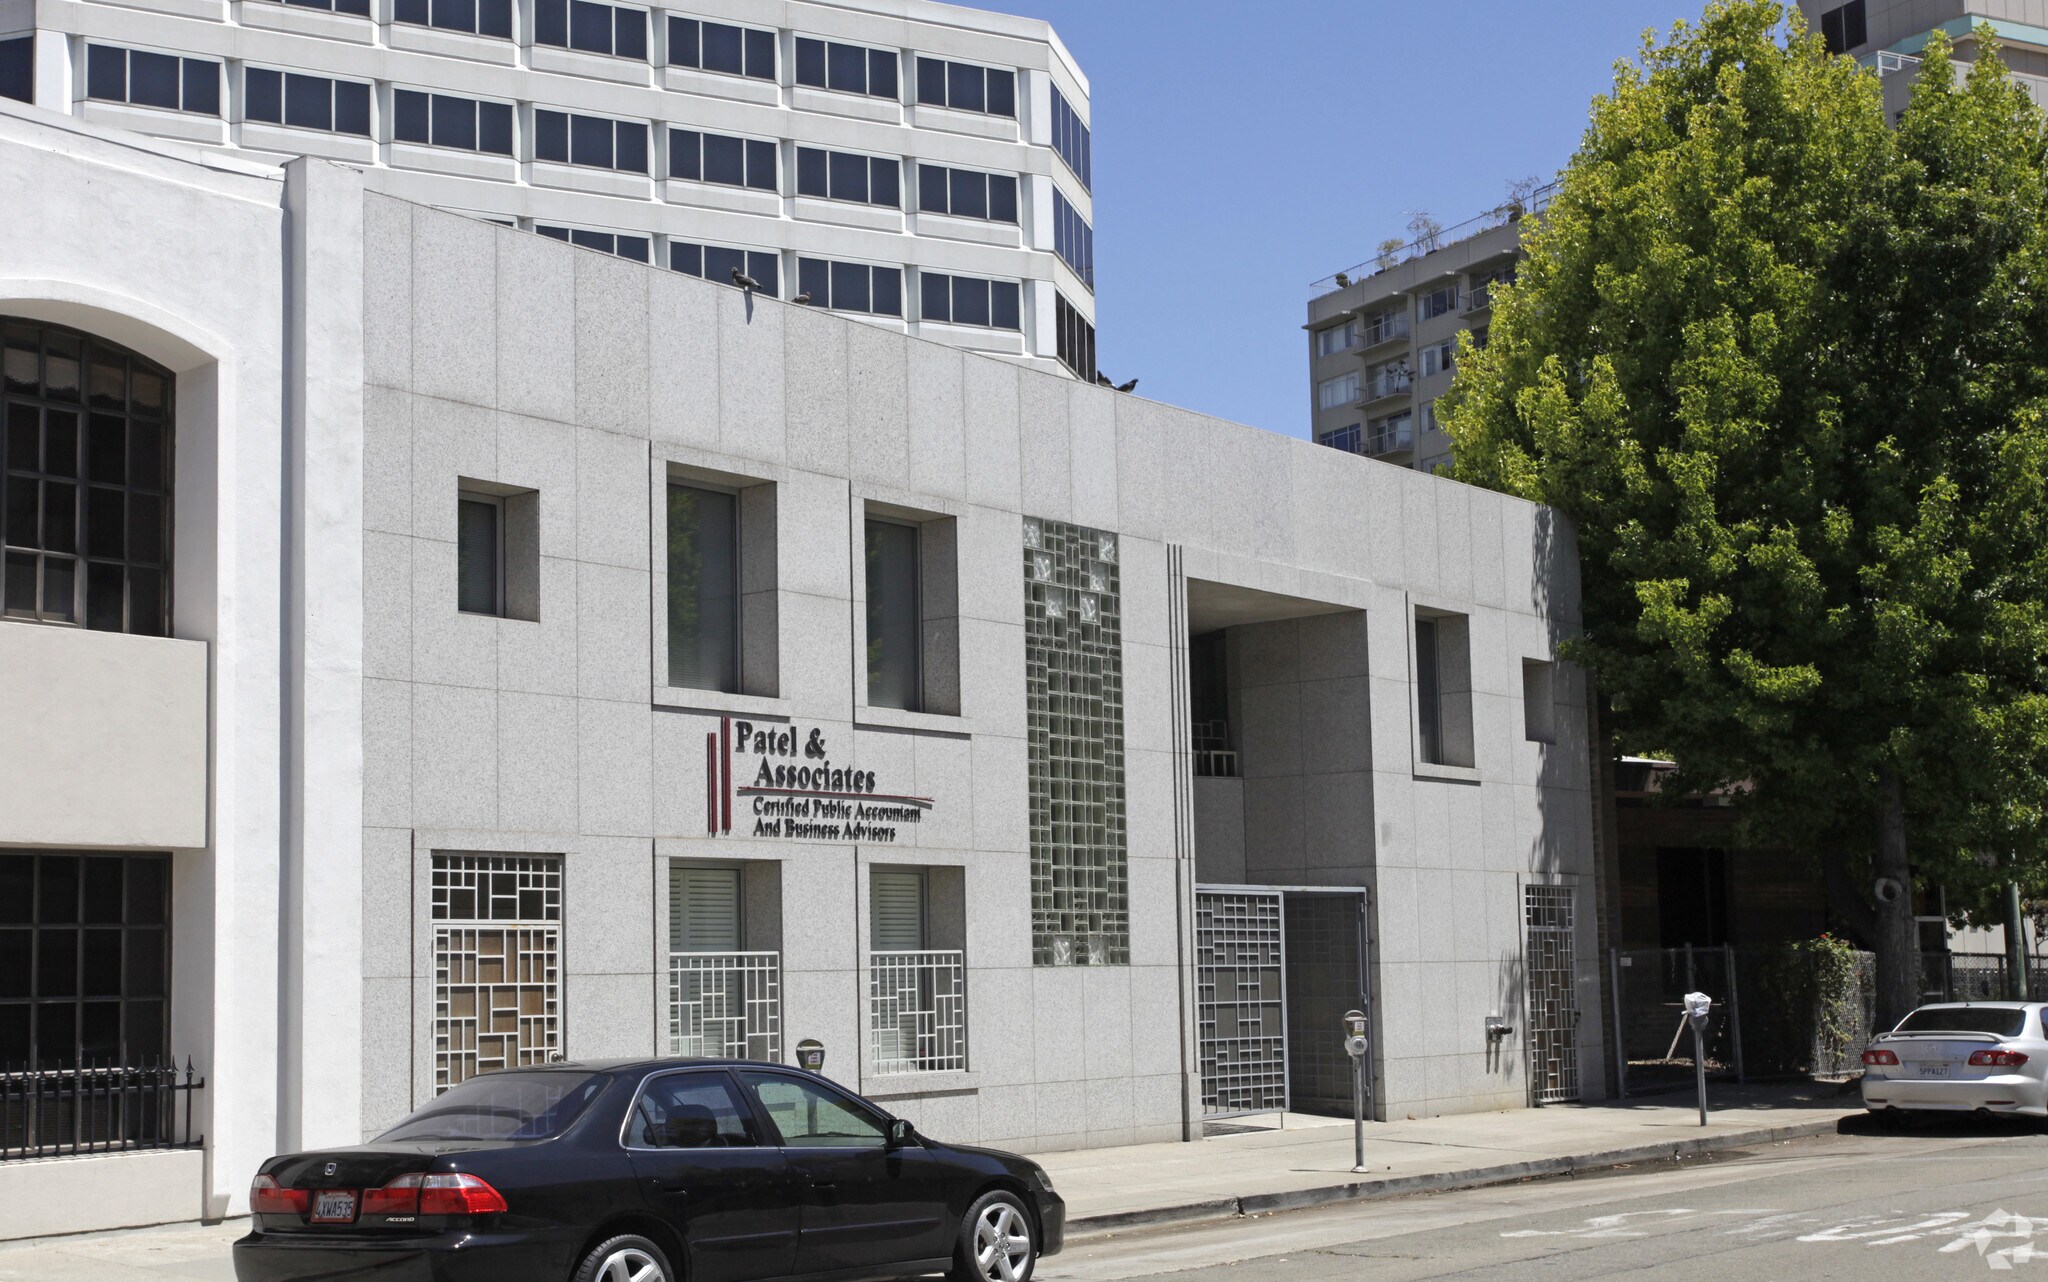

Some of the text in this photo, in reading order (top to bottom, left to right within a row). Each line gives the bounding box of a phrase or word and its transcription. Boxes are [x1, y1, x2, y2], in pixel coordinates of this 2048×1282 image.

[736, 721, 826, 756] Patel &
[754, 756, 876, 791] Associates
[753, 796, 922, 821] Certified Public Accountant
[753, 818, 896, 840] And Business Advisors
[1919, 1067, 1948, 1076] 5PPA127
